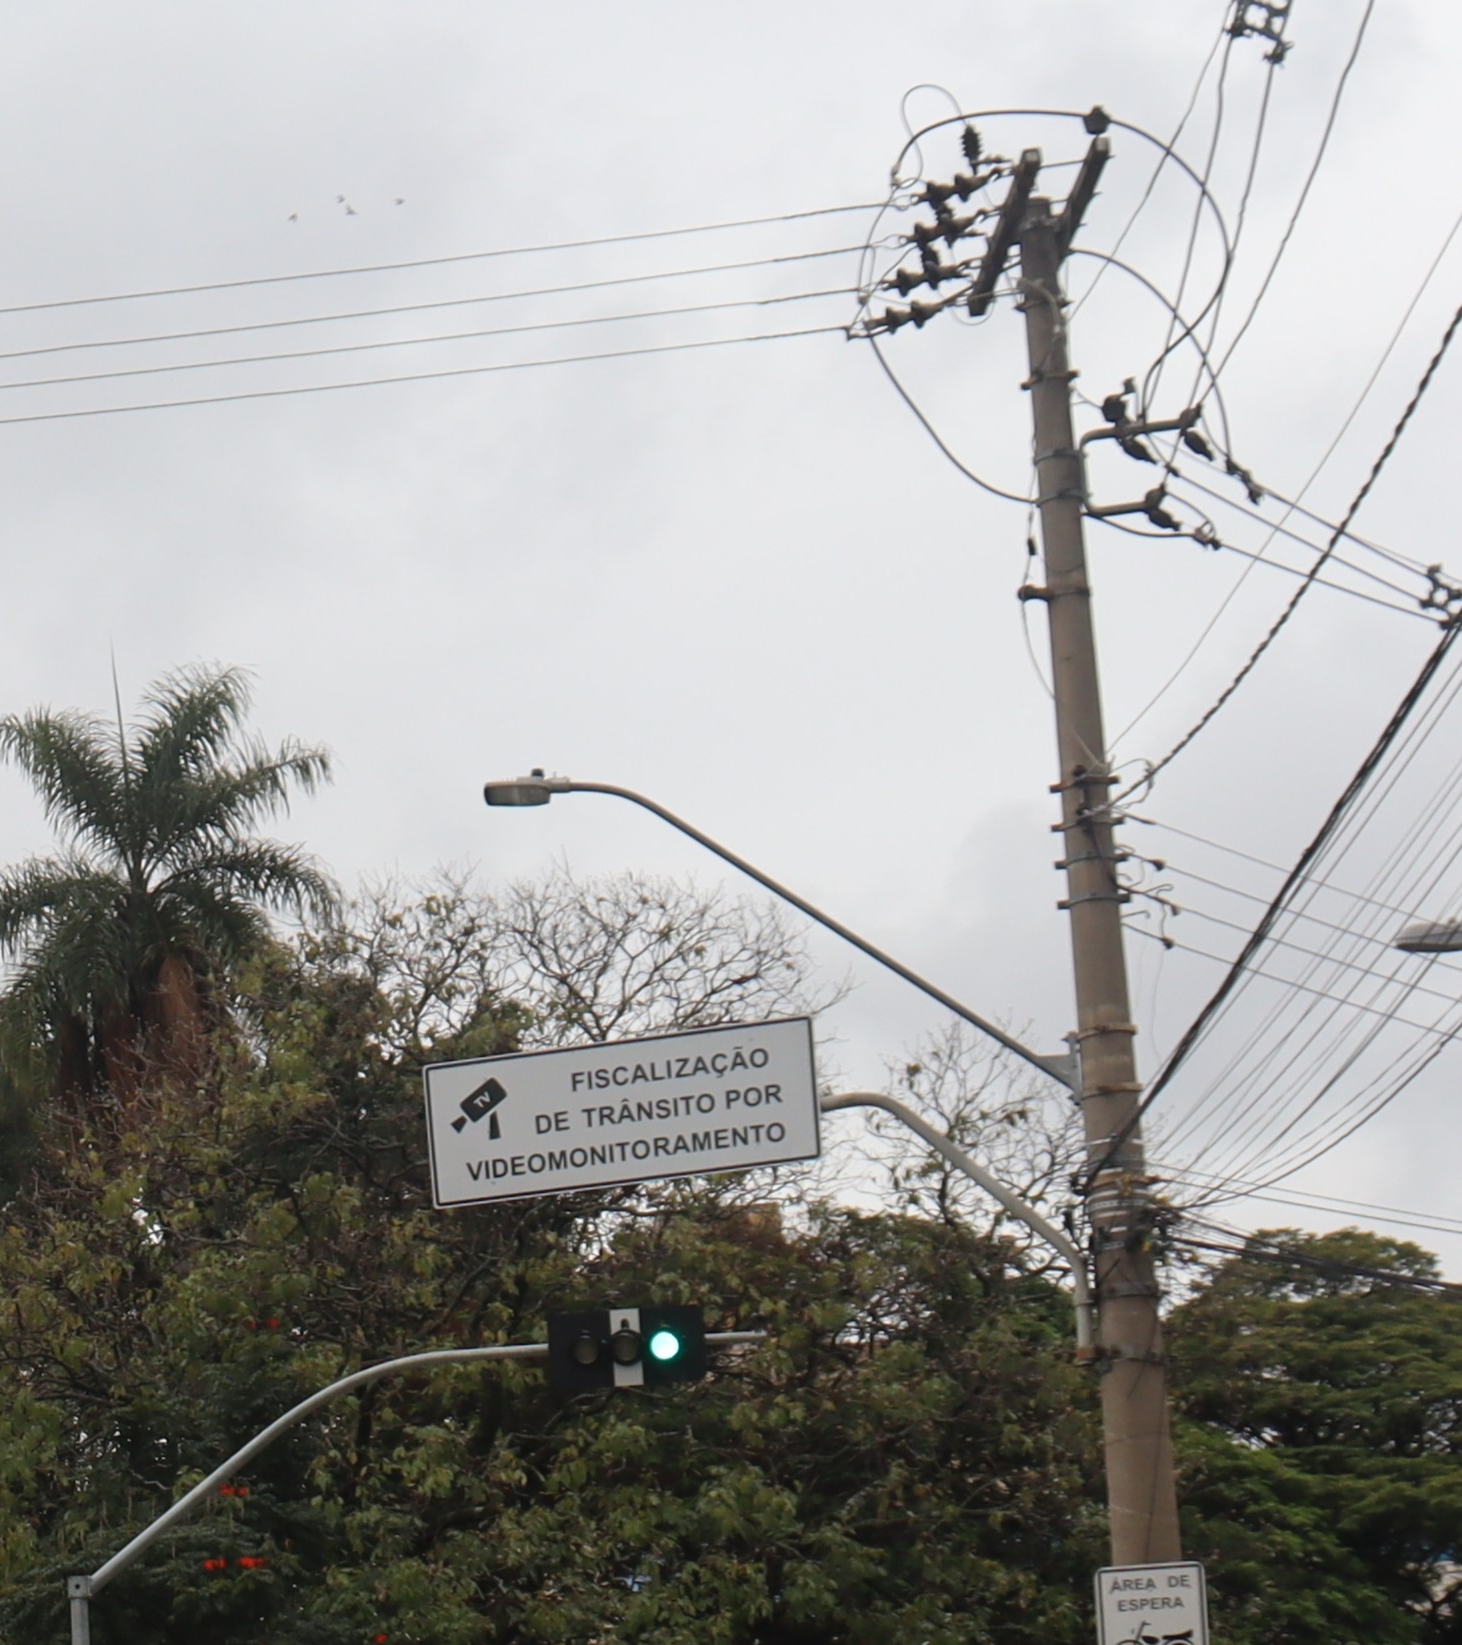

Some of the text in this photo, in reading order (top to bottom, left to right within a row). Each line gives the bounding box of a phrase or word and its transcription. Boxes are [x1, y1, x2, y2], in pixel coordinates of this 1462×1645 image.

[571, 1046, 770, 1092] FISCALIZAÇÃO
[473, 1090, 492, 1109] TV
[535, 1084, 784, 1135] DE TRÂNSITO POR
[466, 1122, 786, 1182] VIDEOMONITORAMENTO
[1109, 1574, 1191, 1593] ÁREA DE
[1118, 1596, 1185, 1612] ESPERA
